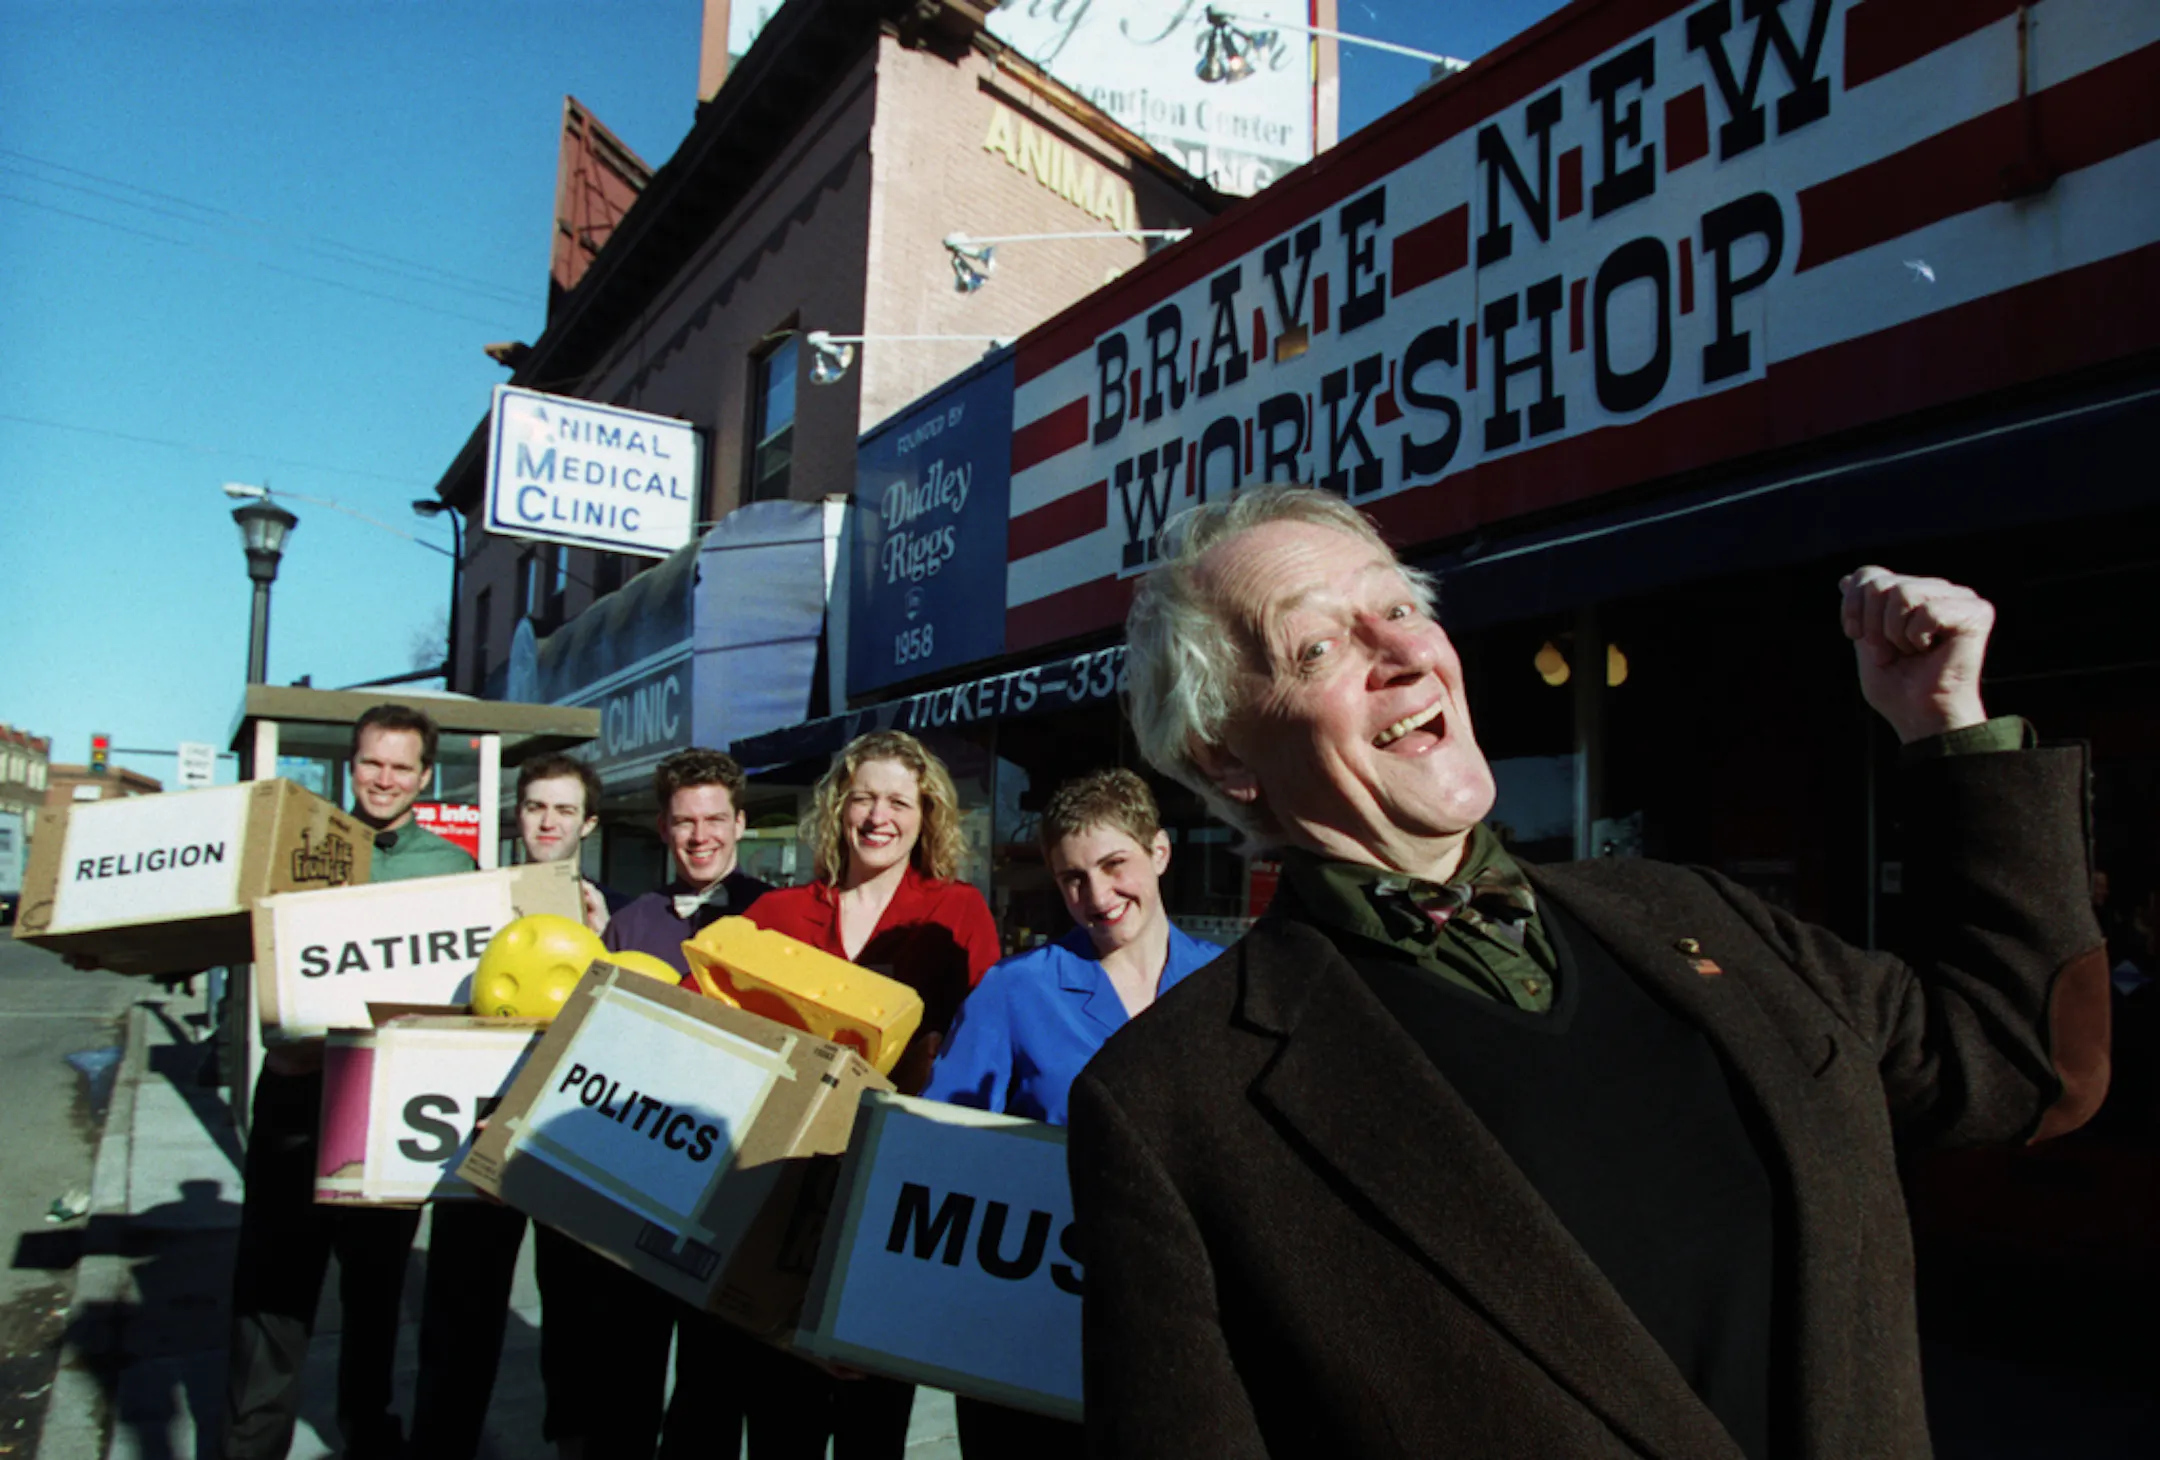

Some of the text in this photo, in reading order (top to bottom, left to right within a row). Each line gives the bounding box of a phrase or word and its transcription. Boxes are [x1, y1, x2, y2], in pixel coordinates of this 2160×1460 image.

[1075, 82, 1294, 147] ention Center
[1093, 0, 1832, 447] BRAVE NEW
[1114, 192, 1784, 569] WORKSHOP
[516, 442, 688, 501] MEDICAL
[881, 459, 972, 531] Dudley
[517, 485, 641, 532] CLINIC
[881, 525, 956, 584] Riggs
[895, 624, 934, 665] 1958
[607, 674, 680, 756] CLINIC
[440, 803, 480, 824] info
[76, 841, 226, 881] RELIGION
[301, 926, 492, 978] SATIRE
[558, 1063, 720, 1163] POLITICS
[885, 1181, 1084, 1296] MUS
